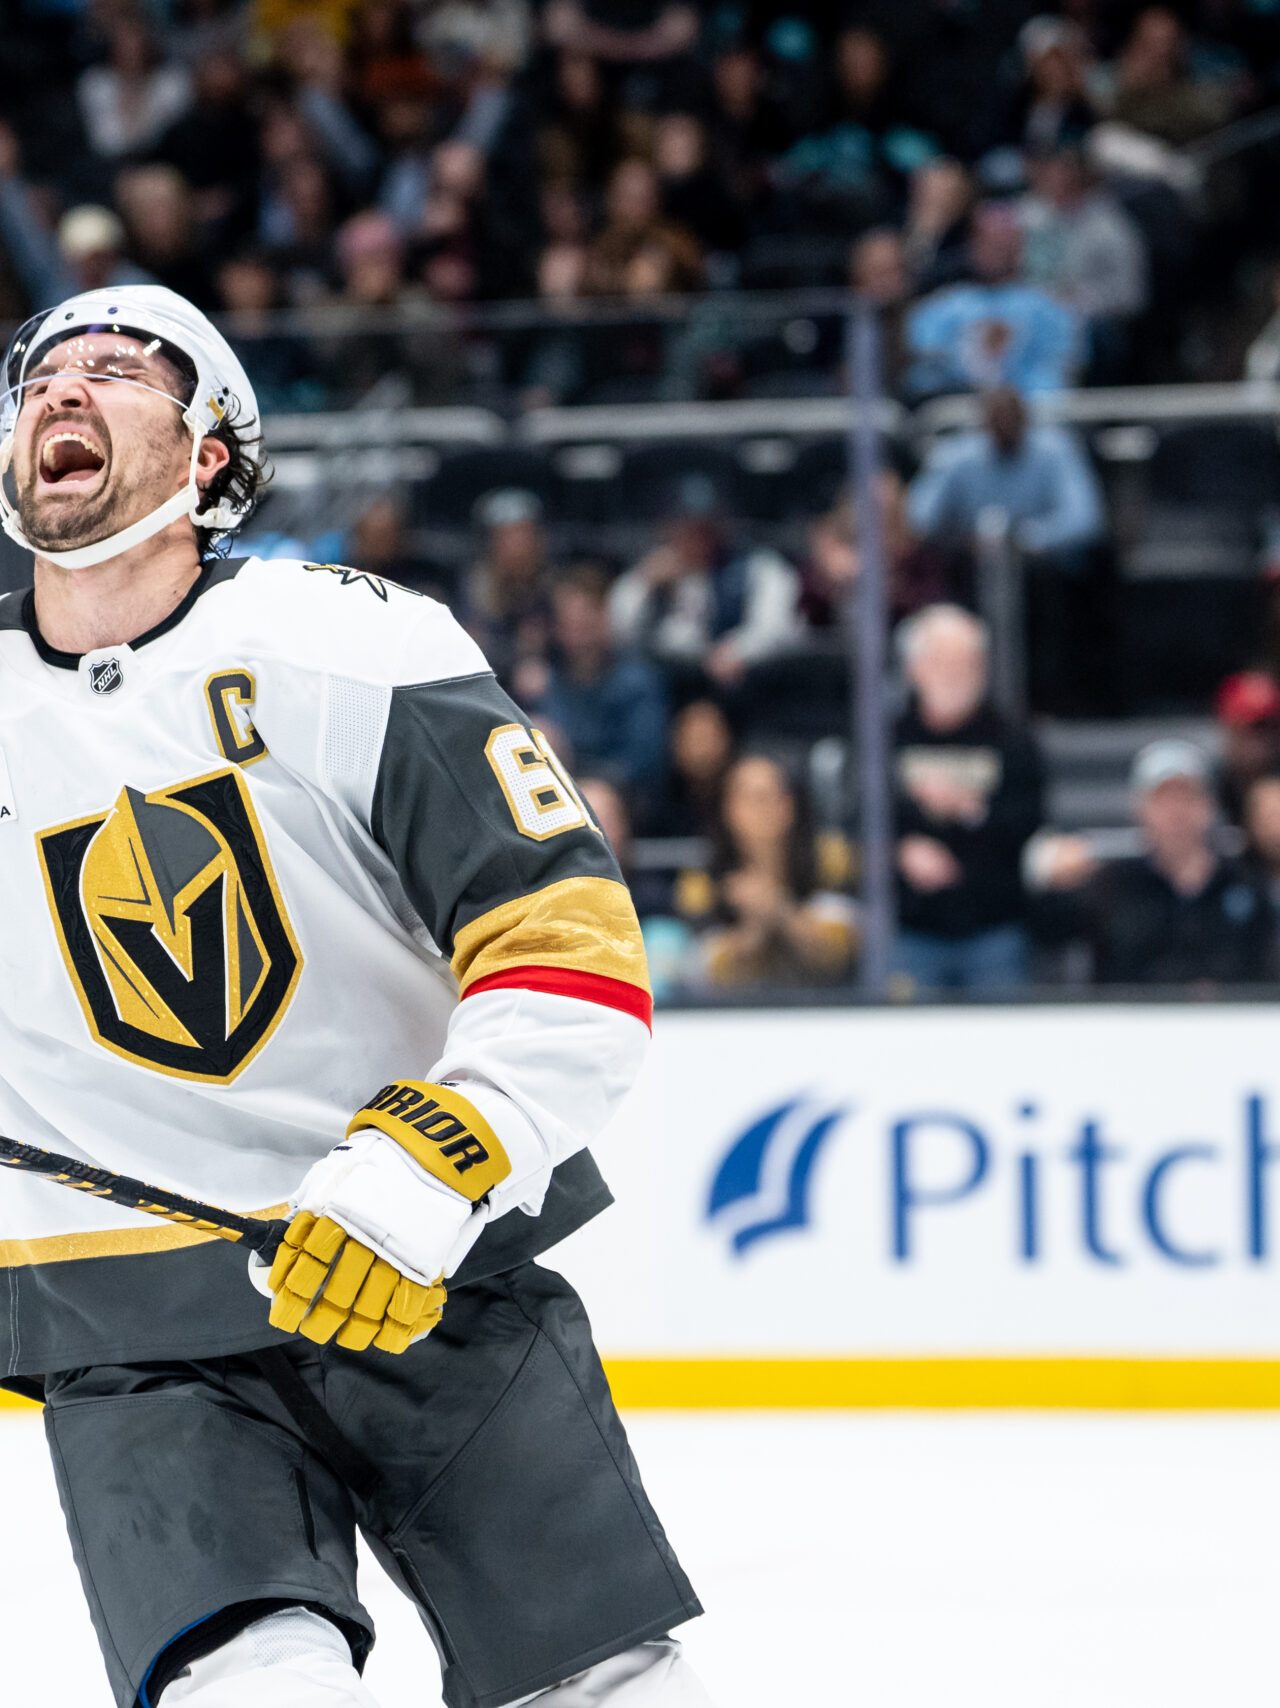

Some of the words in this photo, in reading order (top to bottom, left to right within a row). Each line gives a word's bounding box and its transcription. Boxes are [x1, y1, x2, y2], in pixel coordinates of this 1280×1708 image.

[98, 666, 117, 690] NHL
[204, 668, 269, 769] C
[357, 1084, 489, 1175] RRIOR
